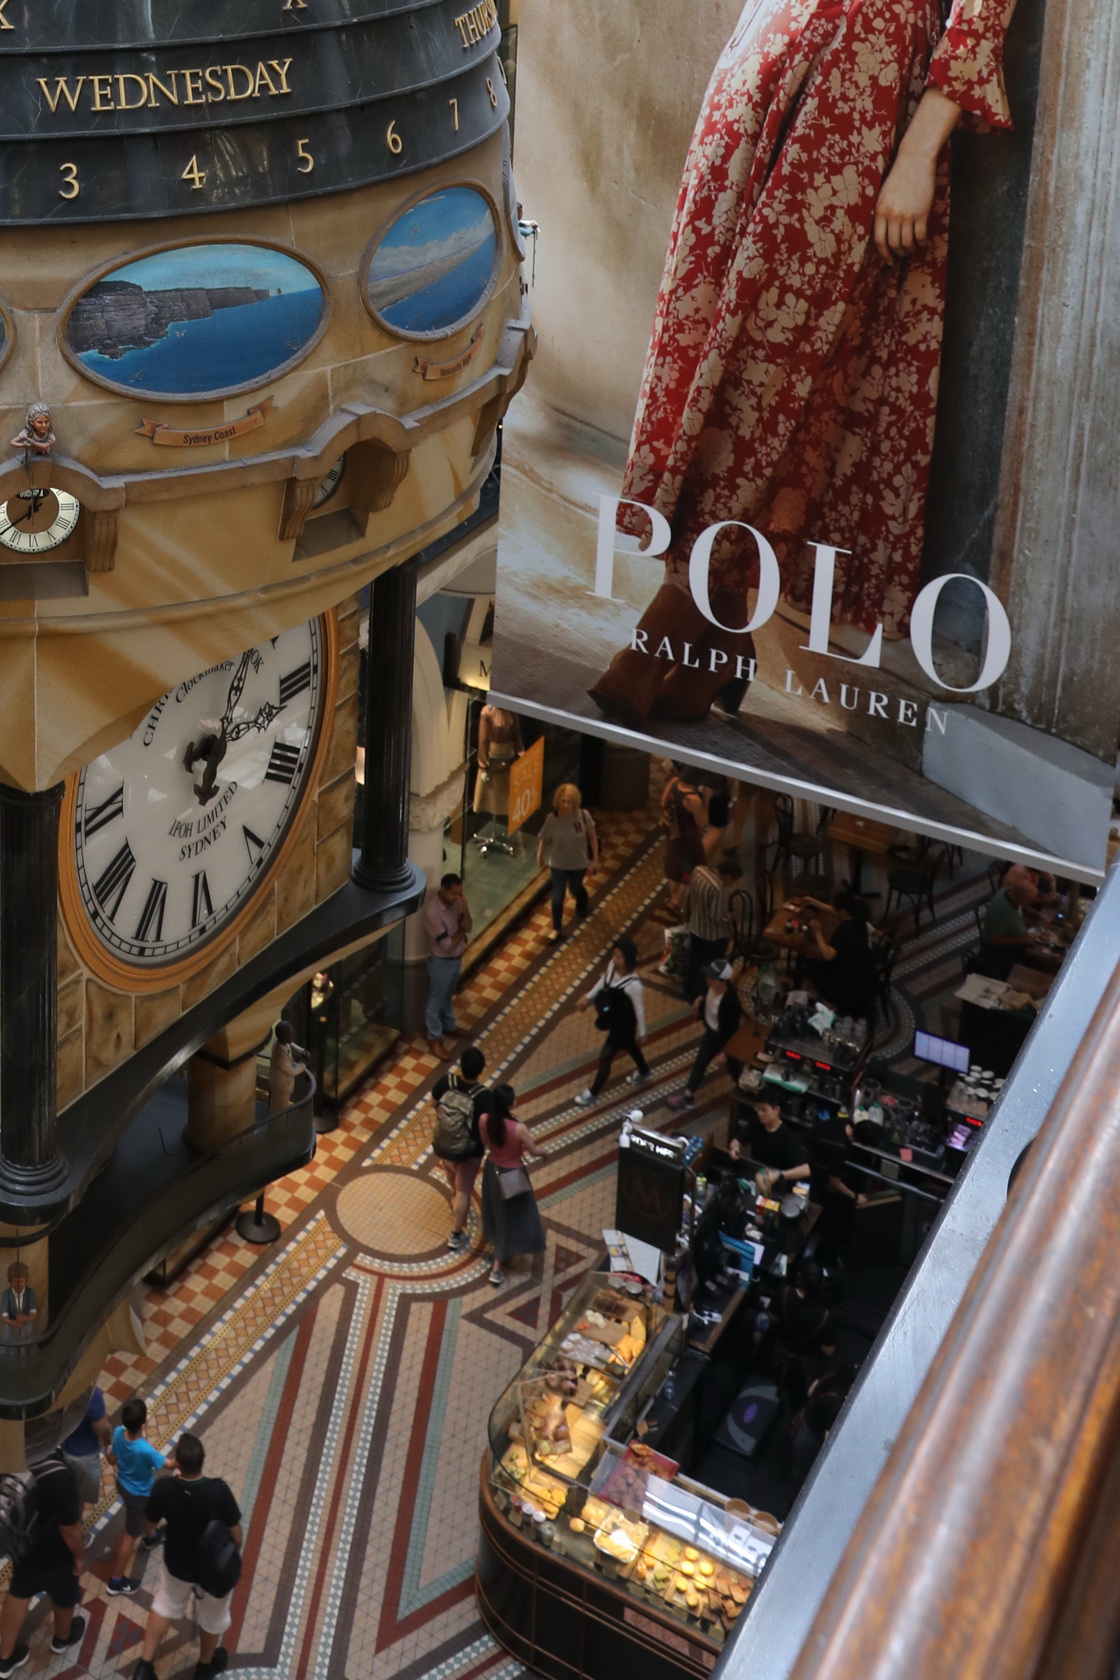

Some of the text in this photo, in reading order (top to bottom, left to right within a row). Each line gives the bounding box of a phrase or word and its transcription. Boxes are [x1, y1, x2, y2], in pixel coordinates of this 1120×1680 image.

[37, 58, 293, 113] WEDNESDAY
[59, 163, 80, 200] 3
[181, 154, 207, 190] 4
[296, 139, 314, 174] 5
[386, 120, 403, 154] 6
[448, 97, 460, 131] 7
[486, 77, 498, 107] 8
[183, 426, 236, 446] Sydney Coast
[587, 492, 1012, 693] POLO
[630, 628, 951, 736] RALPH LAUREN
[168, 781, 238, 839] IPOH LIMITED
[179, 814, 227, 861] SYDNEY
